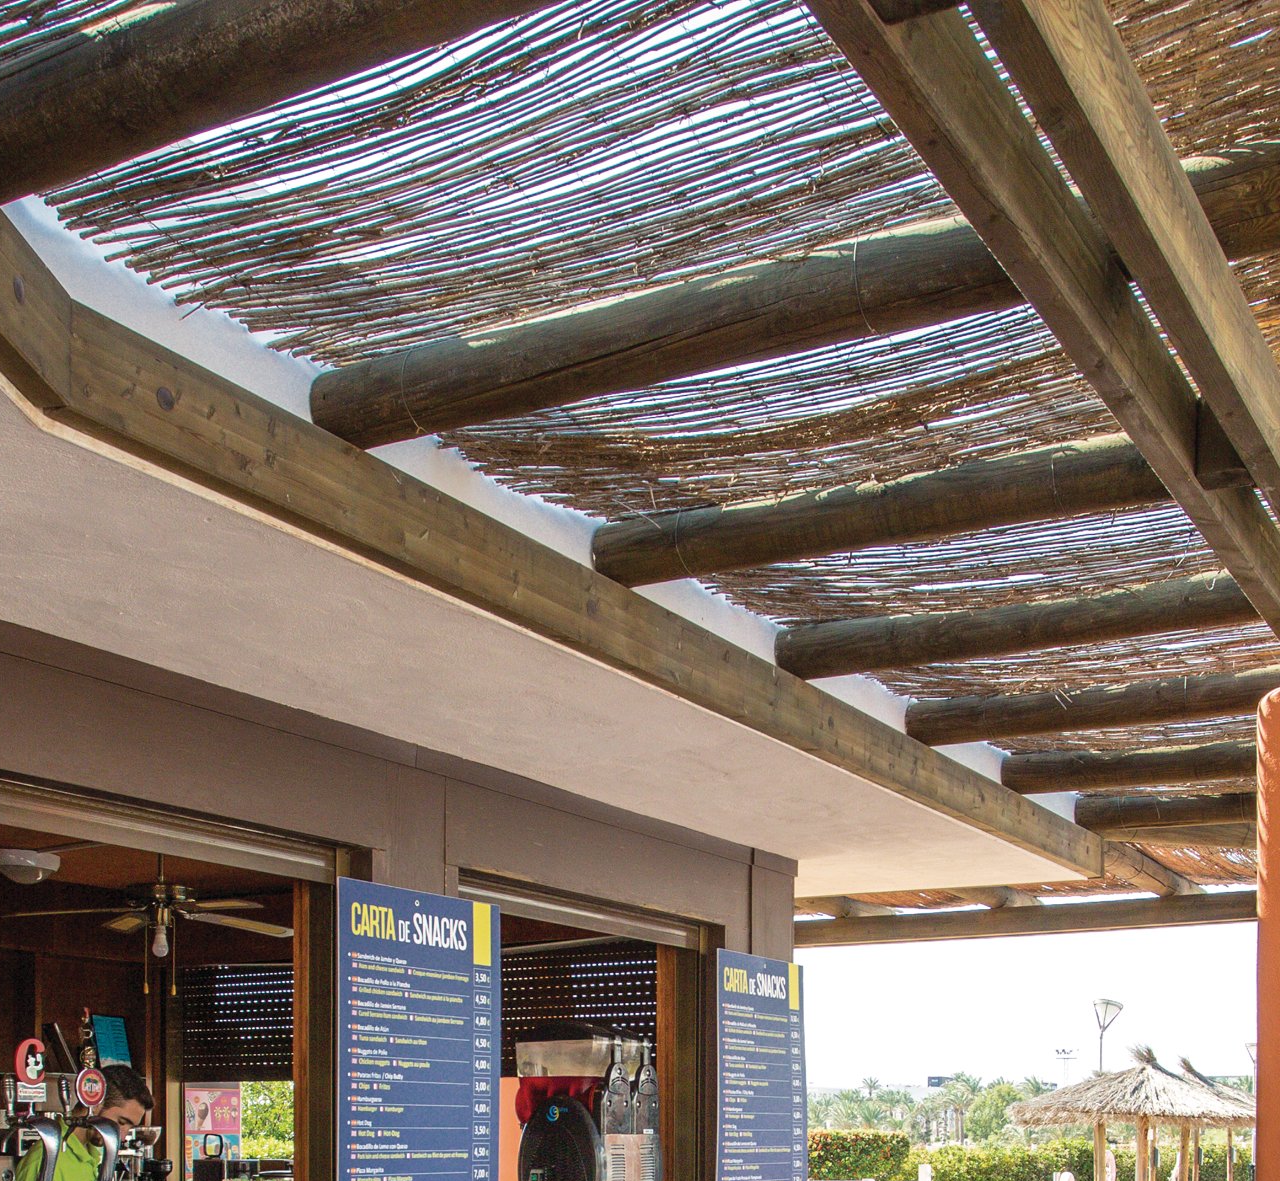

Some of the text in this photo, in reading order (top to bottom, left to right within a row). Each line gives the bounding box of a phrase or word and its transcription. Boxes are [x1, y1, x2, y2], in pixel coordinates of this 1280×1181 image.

[351, 902, 468, 951] CARTA DE SNACKS
[723, 966, 787, 1000] CARTA DE SNACKS
